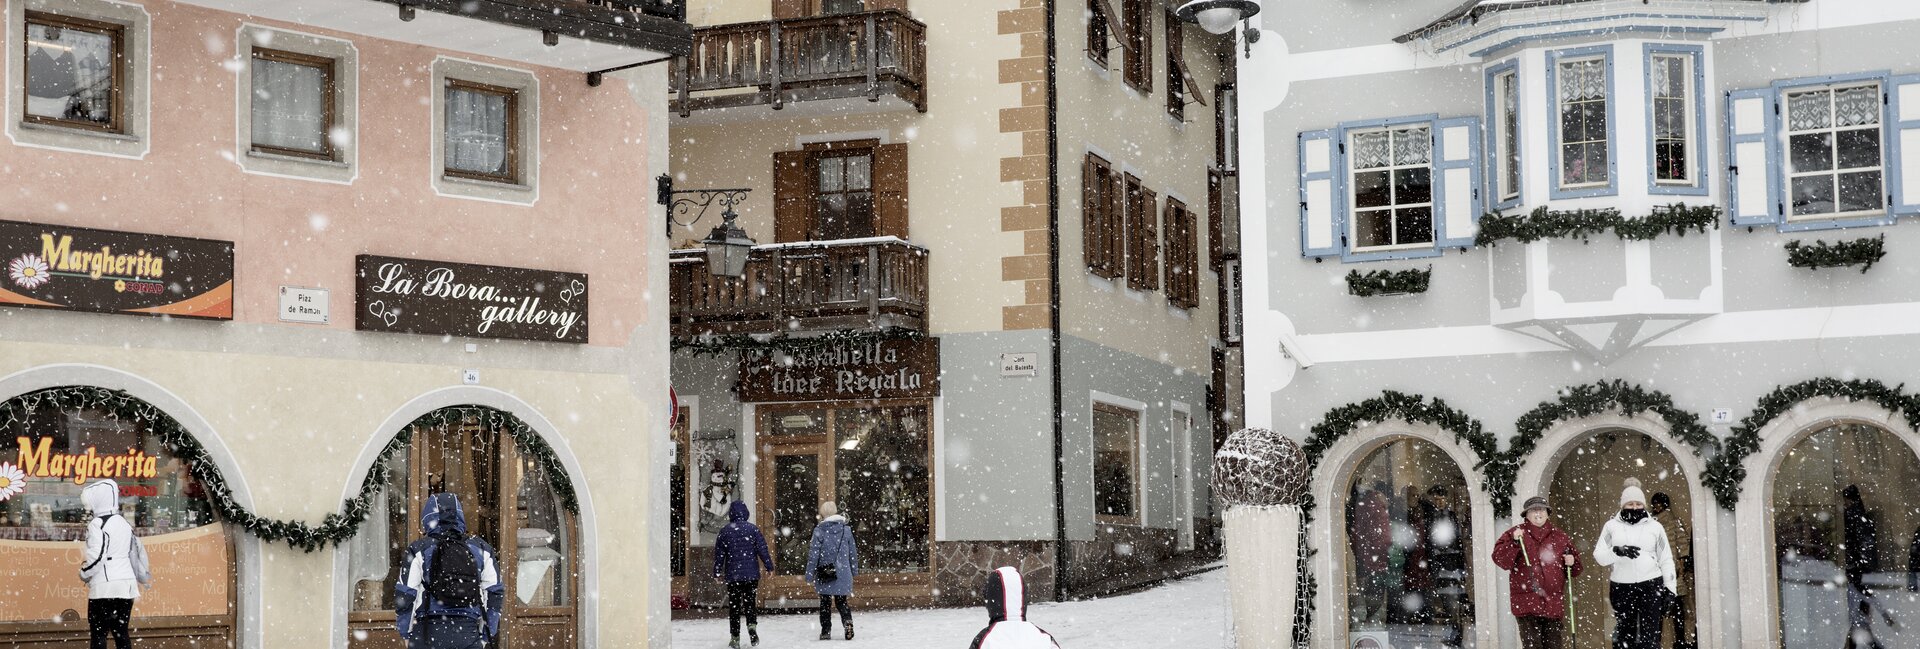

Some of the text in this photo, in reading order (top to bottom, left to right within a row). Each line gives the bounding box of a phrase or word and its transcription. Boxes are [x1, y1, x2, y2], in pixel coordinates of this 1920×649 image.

[40, 233, 164, 280] Margherita
[125, 281, 164, 294] CONAD
[372, 263, 418, 295] La
[288, 305, 296, 313] de
[477, 296, 582, 339] gallery
[1716, 411, 1727, 420] 47
[17, 436, 157, 485] Margherita
